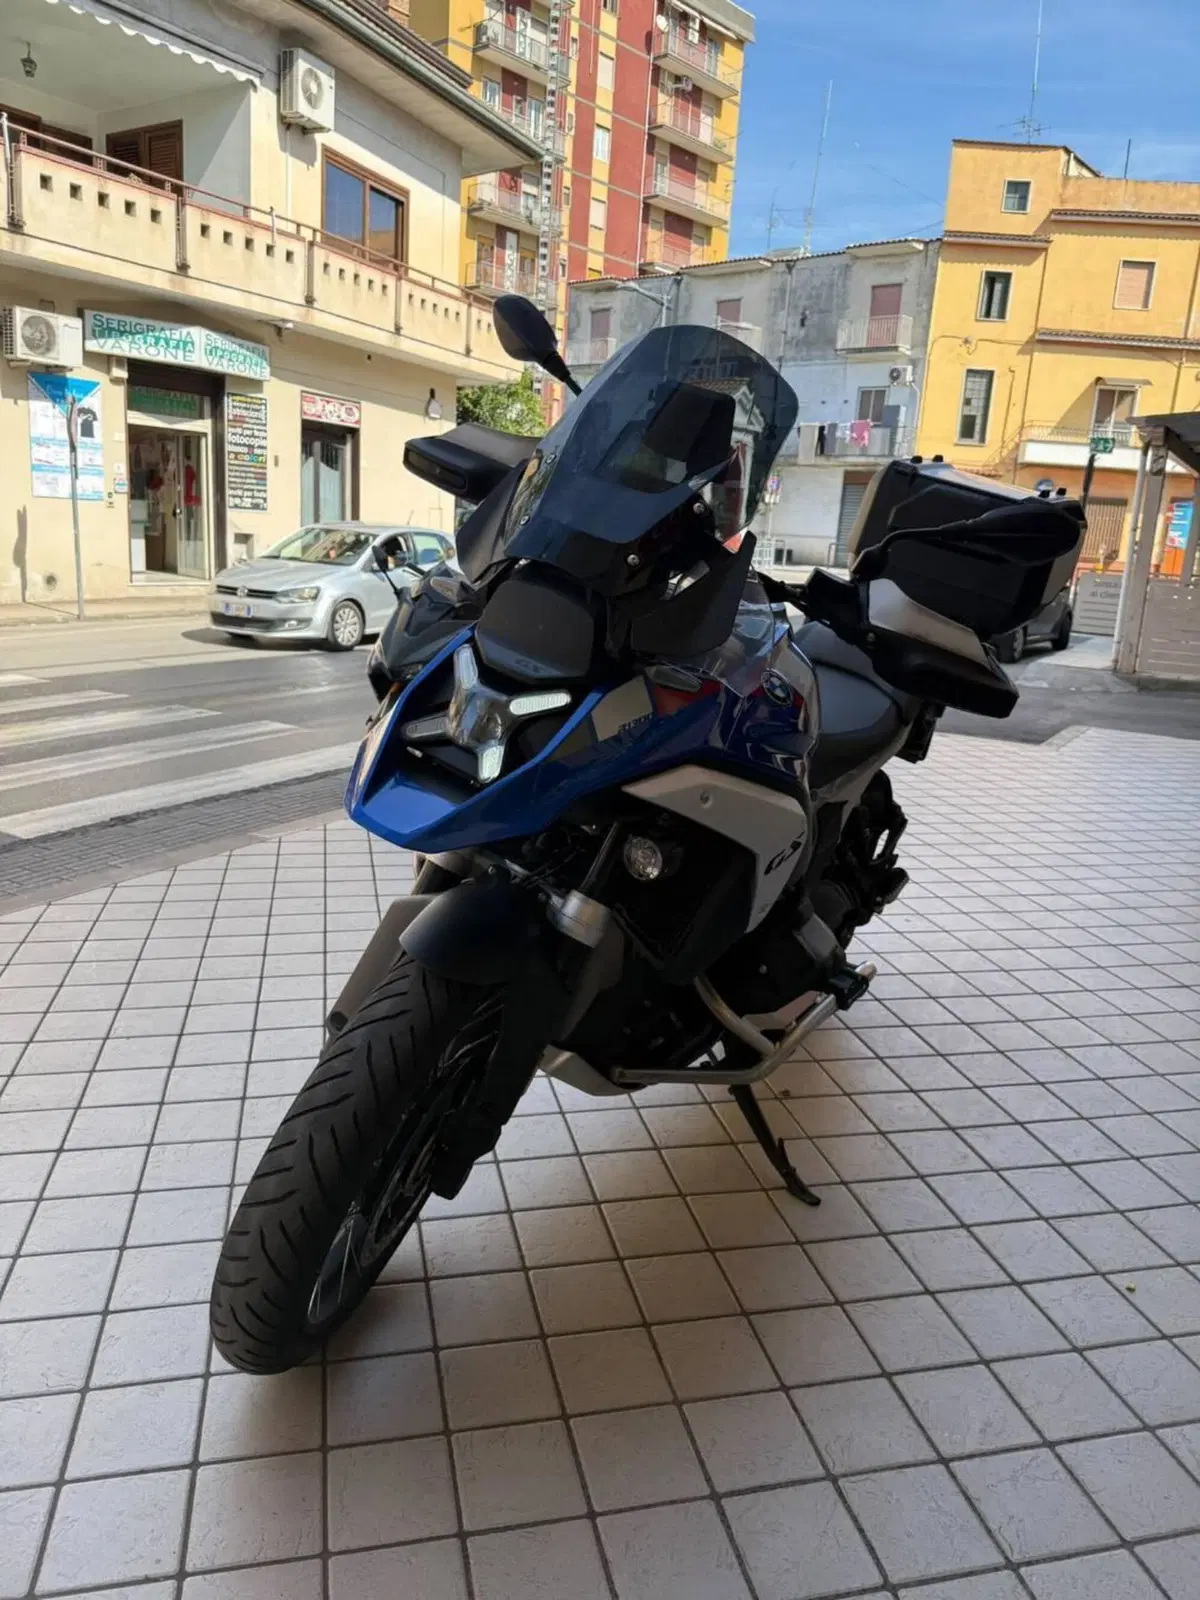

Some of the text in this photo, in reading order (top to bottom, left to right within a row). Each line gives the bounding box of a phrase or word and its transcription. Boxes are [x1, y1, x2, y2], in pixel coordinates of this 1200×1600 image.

[92, 313, 194, 341] SERIGRAFIA
[93, 328, 194, 351] TIPOGRAFIA
[205, 333, 267, 360] SERIGRAFIA
[95, 340, 194, 362] VARONE
[206, 347, 266, 368] TIPOGRAFIA
[206, 358, 267, 379] VARONE
